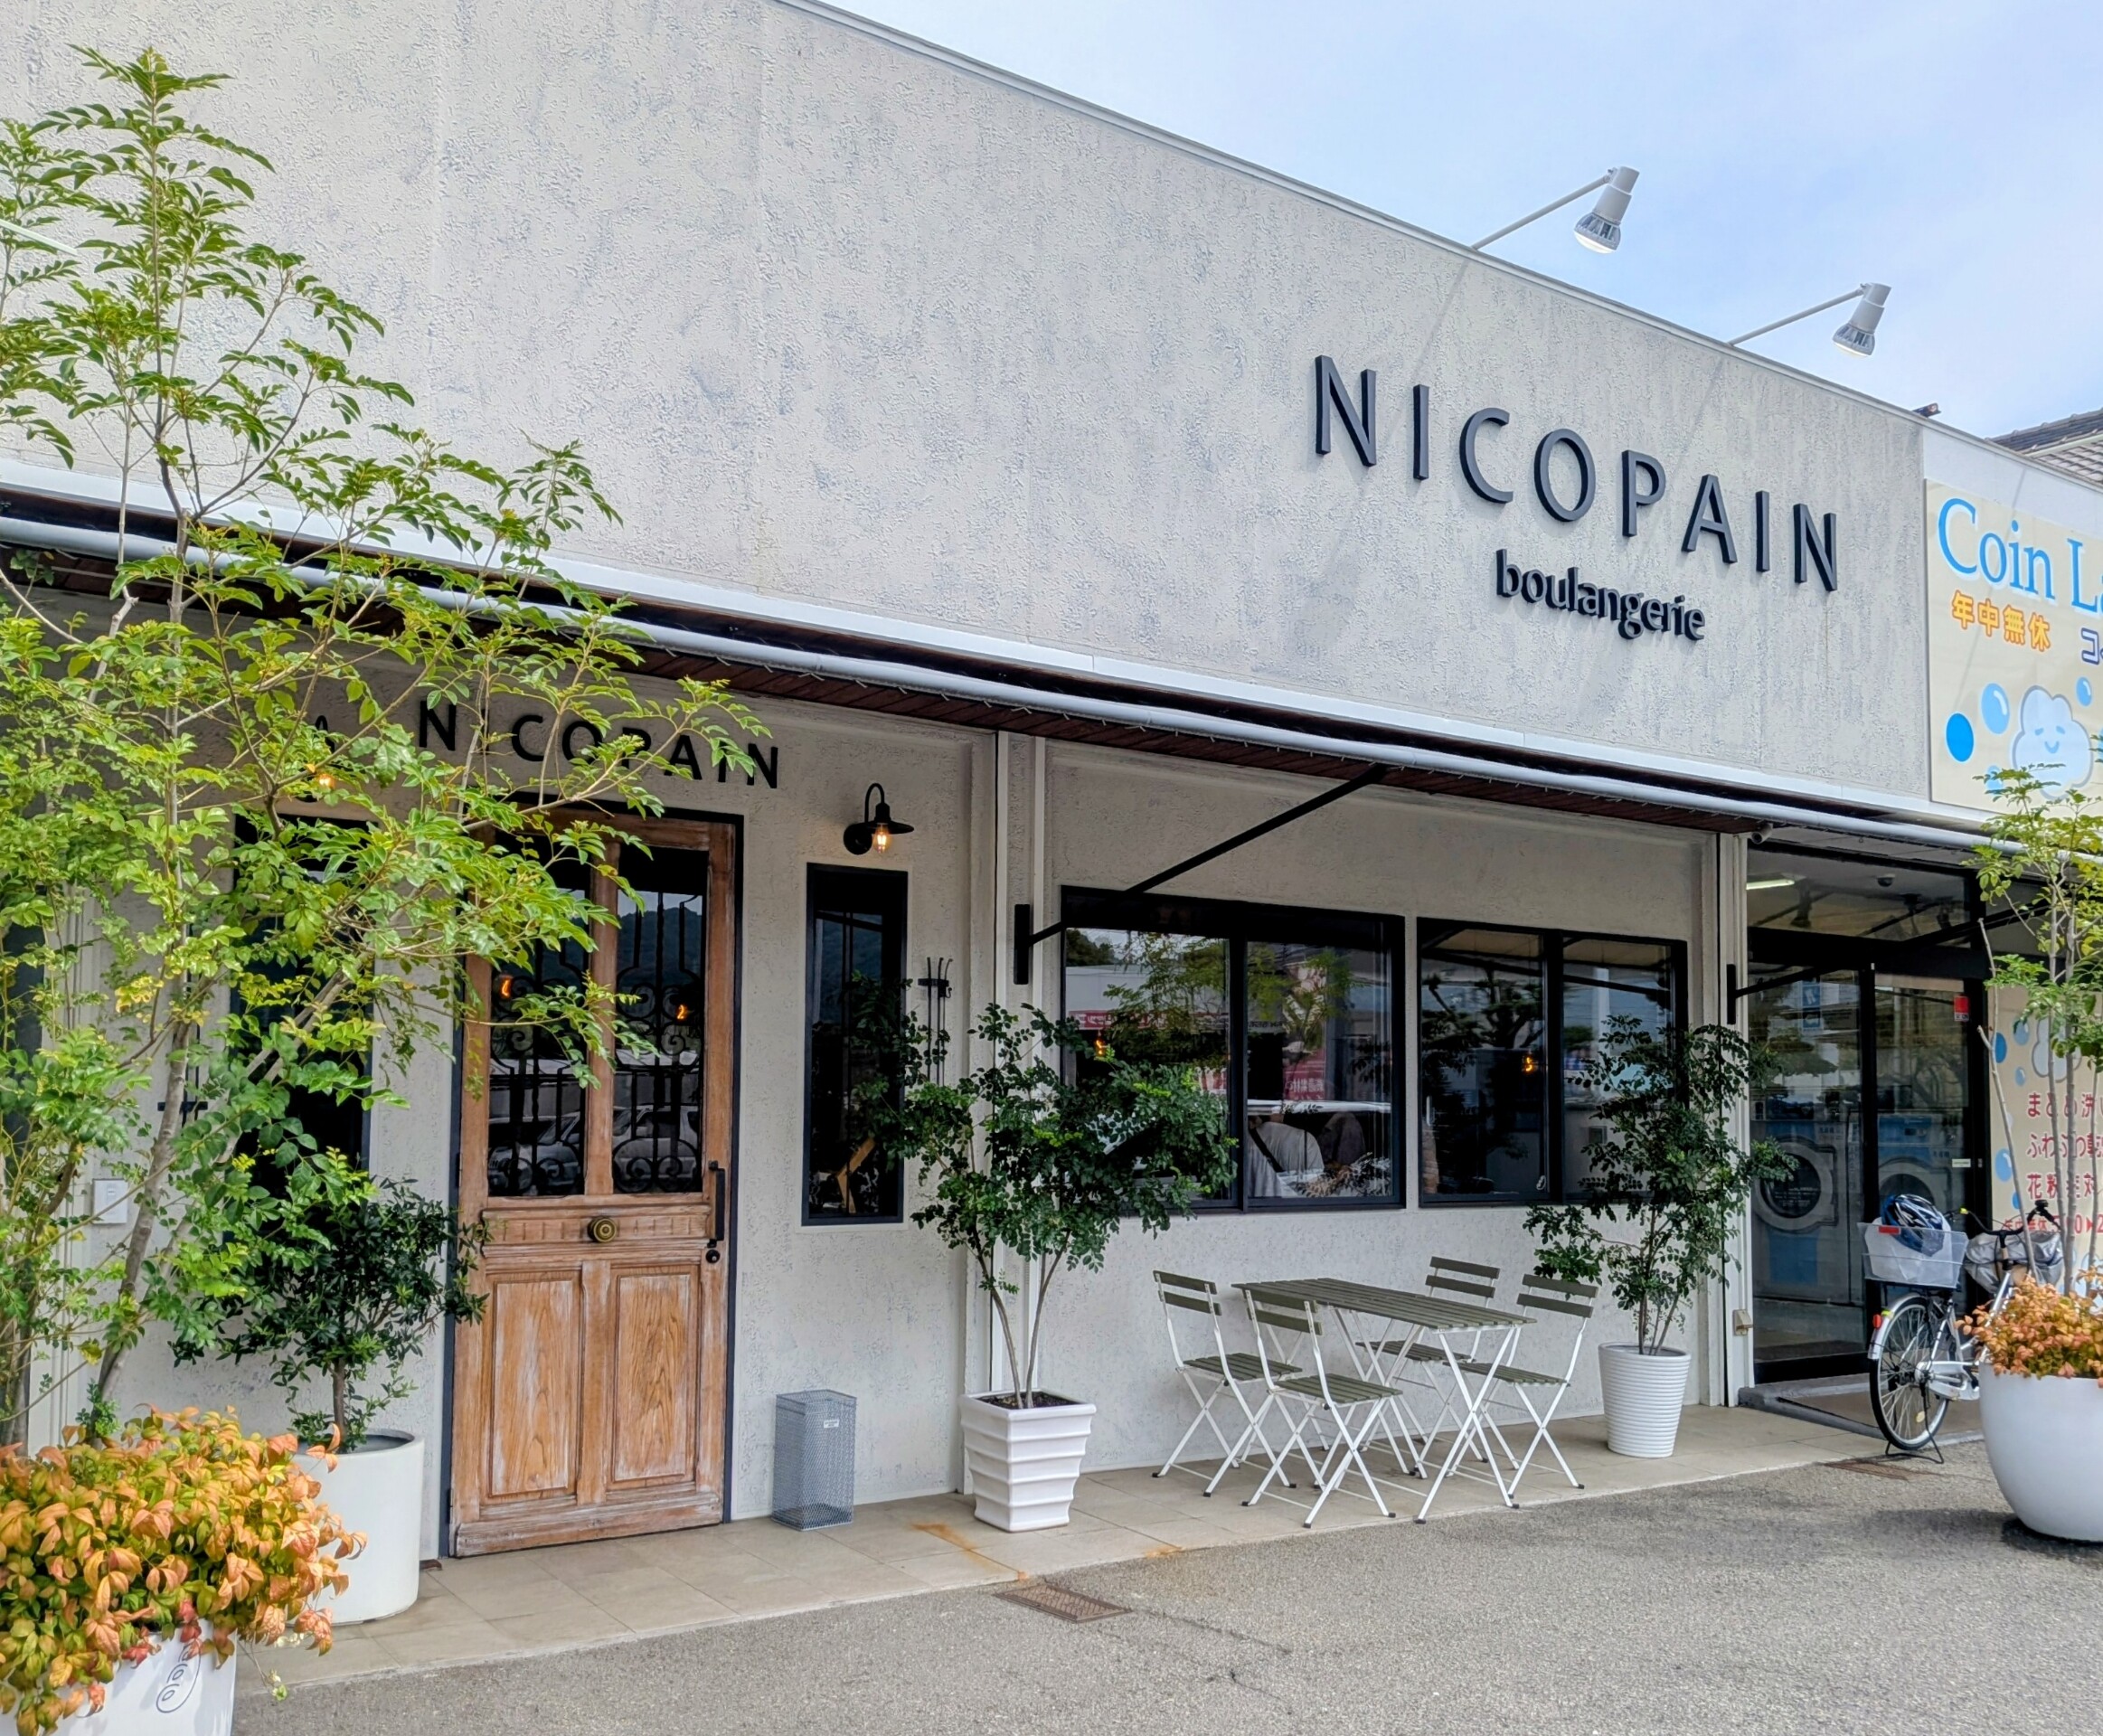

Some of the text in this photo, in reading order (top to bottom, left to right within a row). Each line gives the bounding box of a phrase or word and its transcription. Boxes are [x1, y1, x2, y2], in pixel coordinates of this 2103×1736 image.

[1315, 355, 1837, 591] NICOPAIN
[1496, 549, 1705, 640] boulangerie
[1938, 498, 2103, 615] Coin L
[1951, 590, 2051, 652] 年中無休
[2081, 627, 2103, 665] コ
